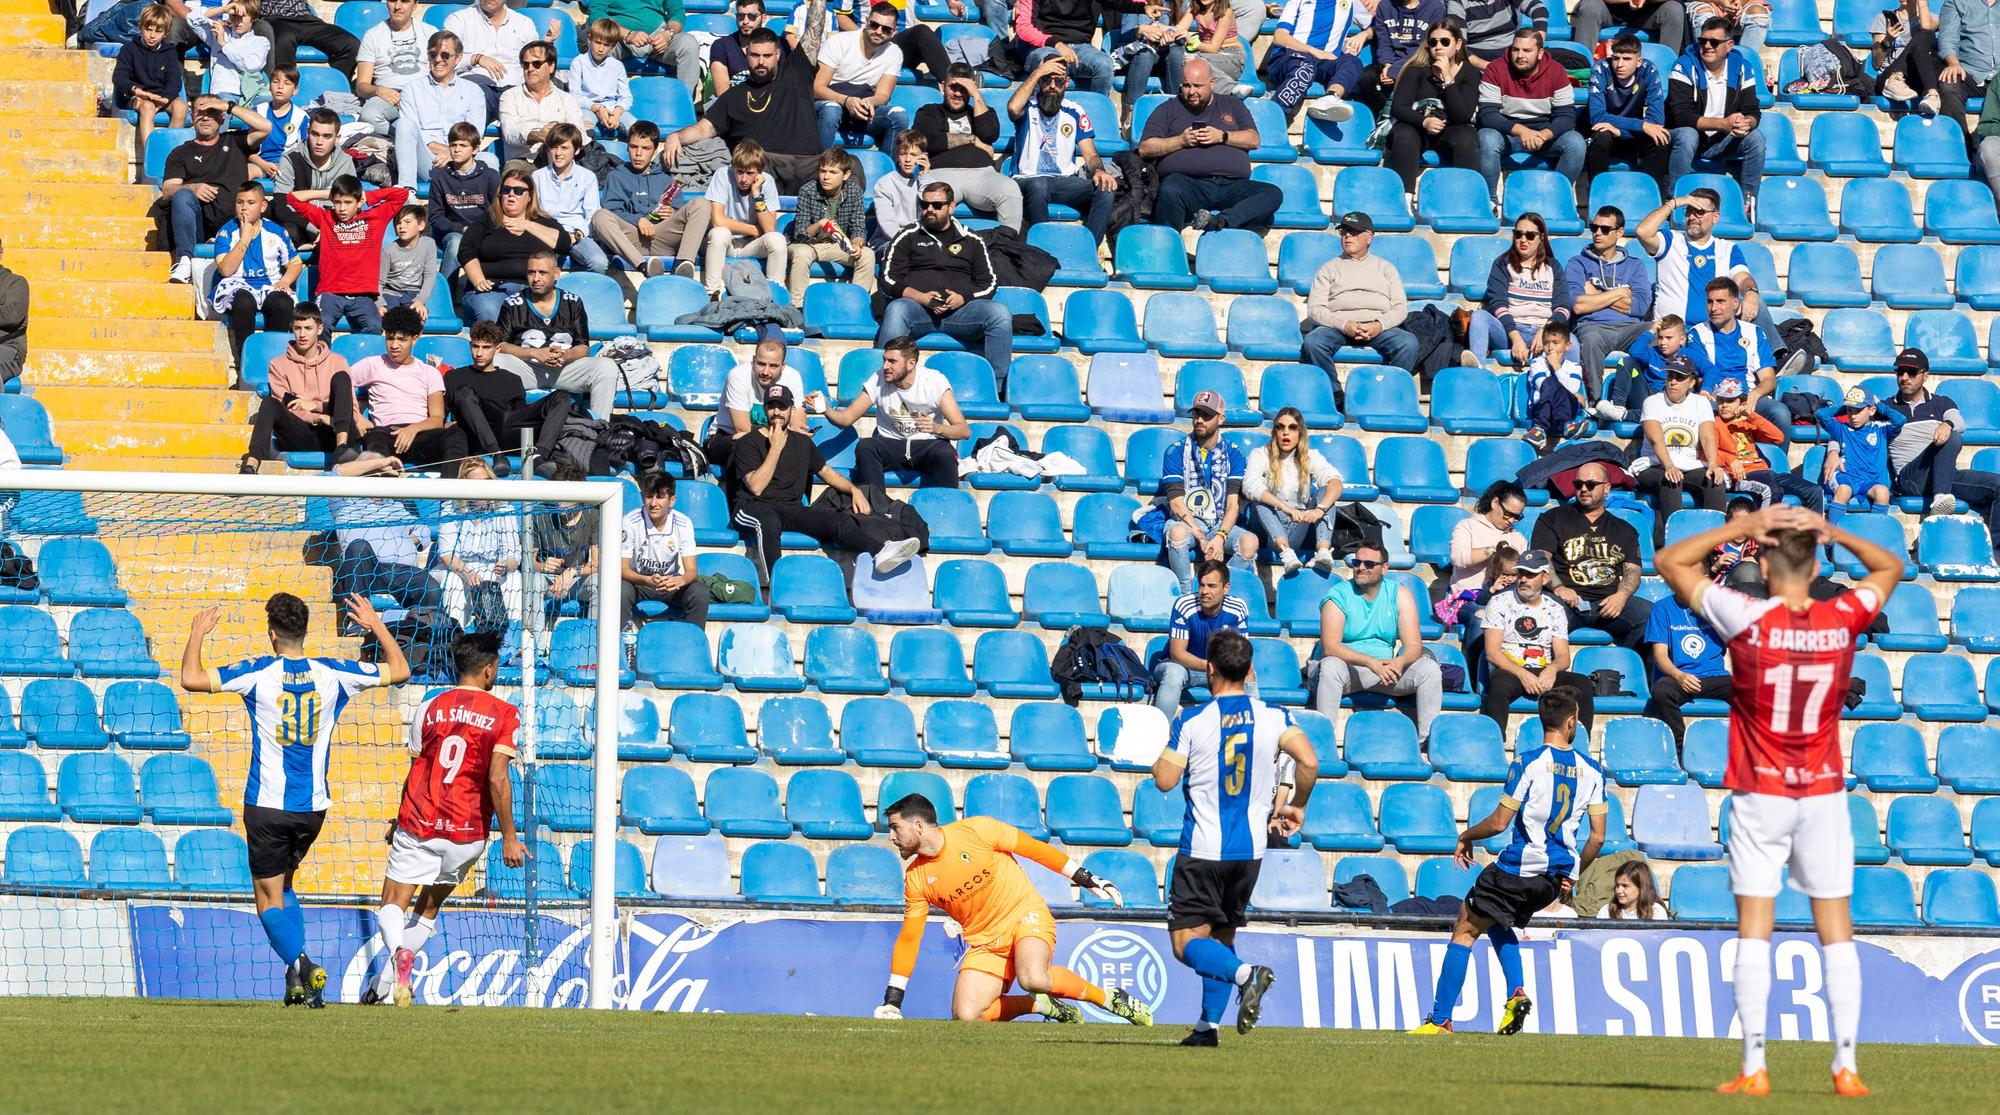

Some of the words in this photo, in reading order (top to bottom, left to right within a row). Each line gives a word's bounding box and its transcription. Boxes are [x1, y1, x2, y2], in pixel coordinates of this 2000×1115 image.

[1748, 624, 1763, 648] J.
[1768, 627, 1850, 652] BARRERO
[426, 711, 434, 726] J.
[435, 708, 447, 723] A.
[449, 704, 496, 731] SÁNCHEZ
[1763, 662, 1835, 735] 17
[275, 691, 322, 747] 30
[438, 734, 468, 784] 9
[1225, 732, 1248, 796] 5
[1548, 783, 1571, 834] 2
[1101, 962, 1134, 975] RF
[1981, 984, 2000, 1004] R
[1984, 1011, 2000, 1029] E
